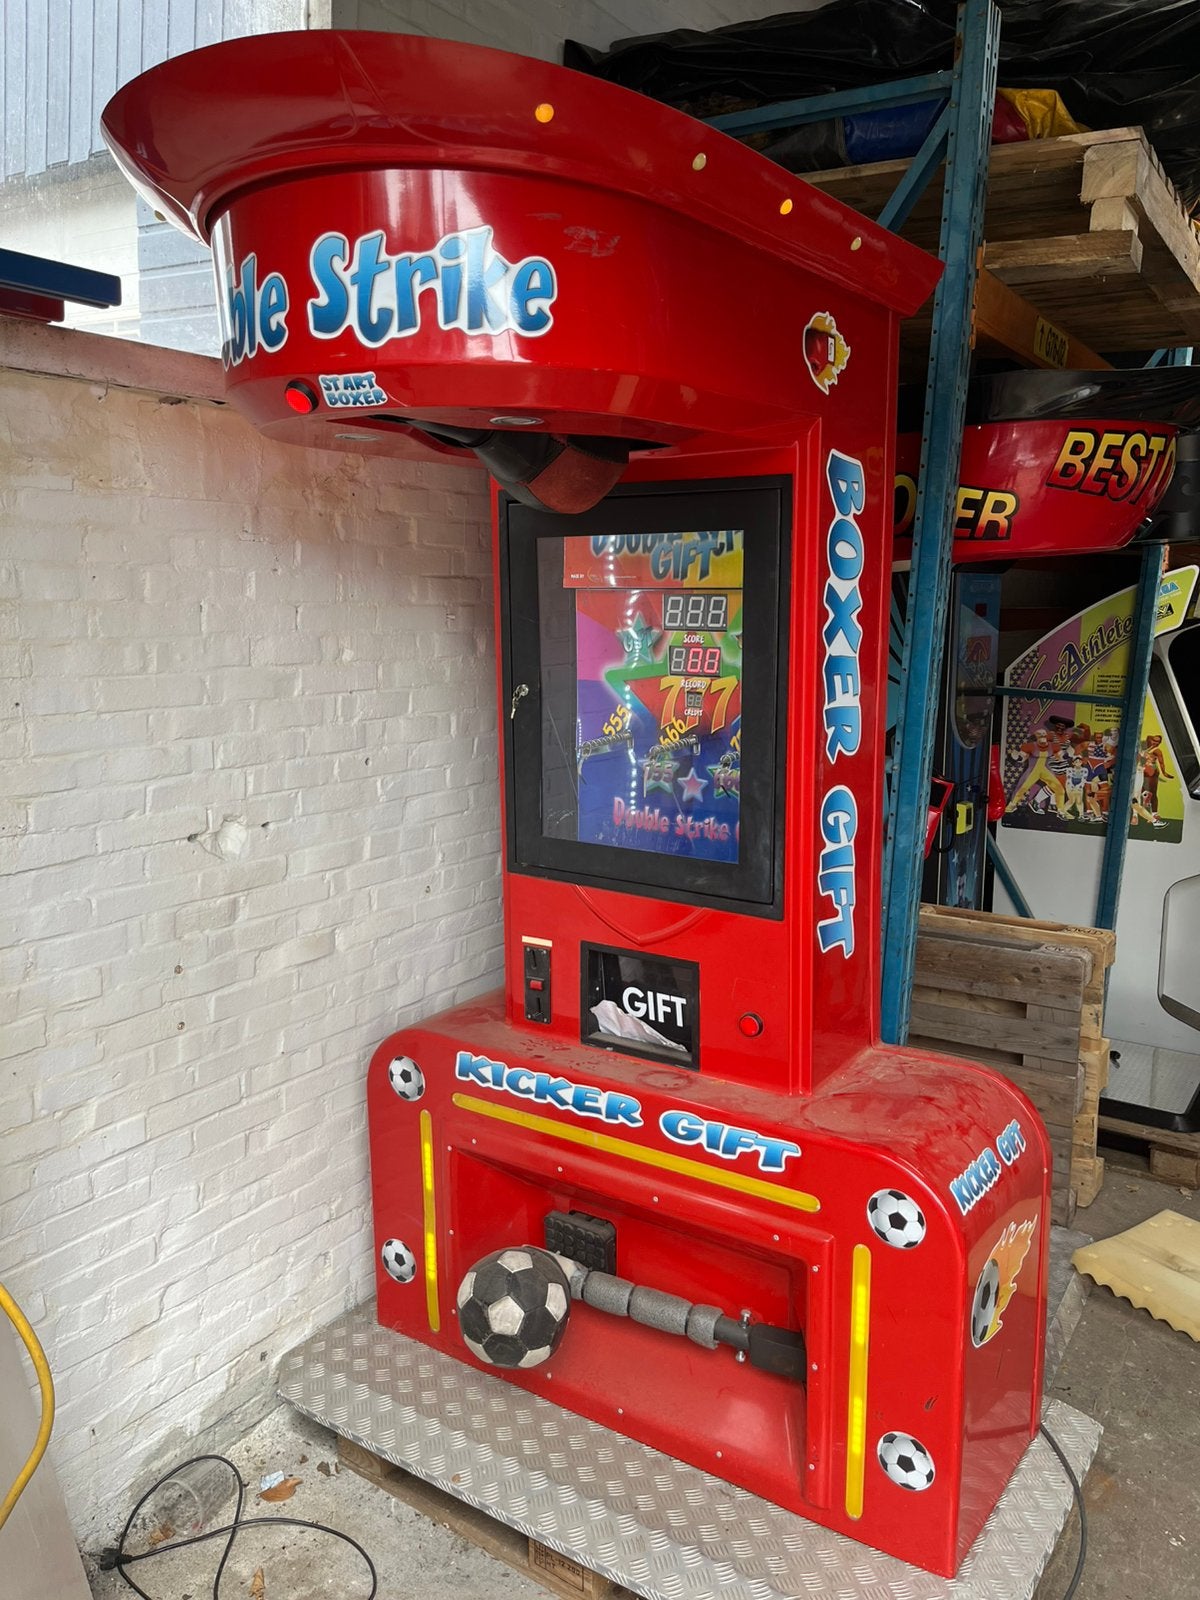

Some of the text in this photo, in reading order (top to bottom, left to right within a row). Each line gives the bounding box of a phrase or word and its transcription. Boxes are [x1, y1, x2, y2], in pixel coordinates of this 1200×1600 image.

[307, 226, 556, 345] Strike
[319, 373, 375, 392] START
[326, 390, 386, 407] BOXER
[651, 541, 716, 582] GIFT
[823, 448, 866, 765] BOXER
[683, 634, 705, 644] SCORE
[681, 679, 707, 689] RECORD
[613, 797, 670, 833] Double
[675, 814, 730, 841] Strike
[814, 785, 859, 960] GIFT
[622, 986, 687, 1027] GIFT
[456, 1051, 801, 1172] KICKER GIFT
[950, 1119, 1026, 1216] KICKER GIFT
